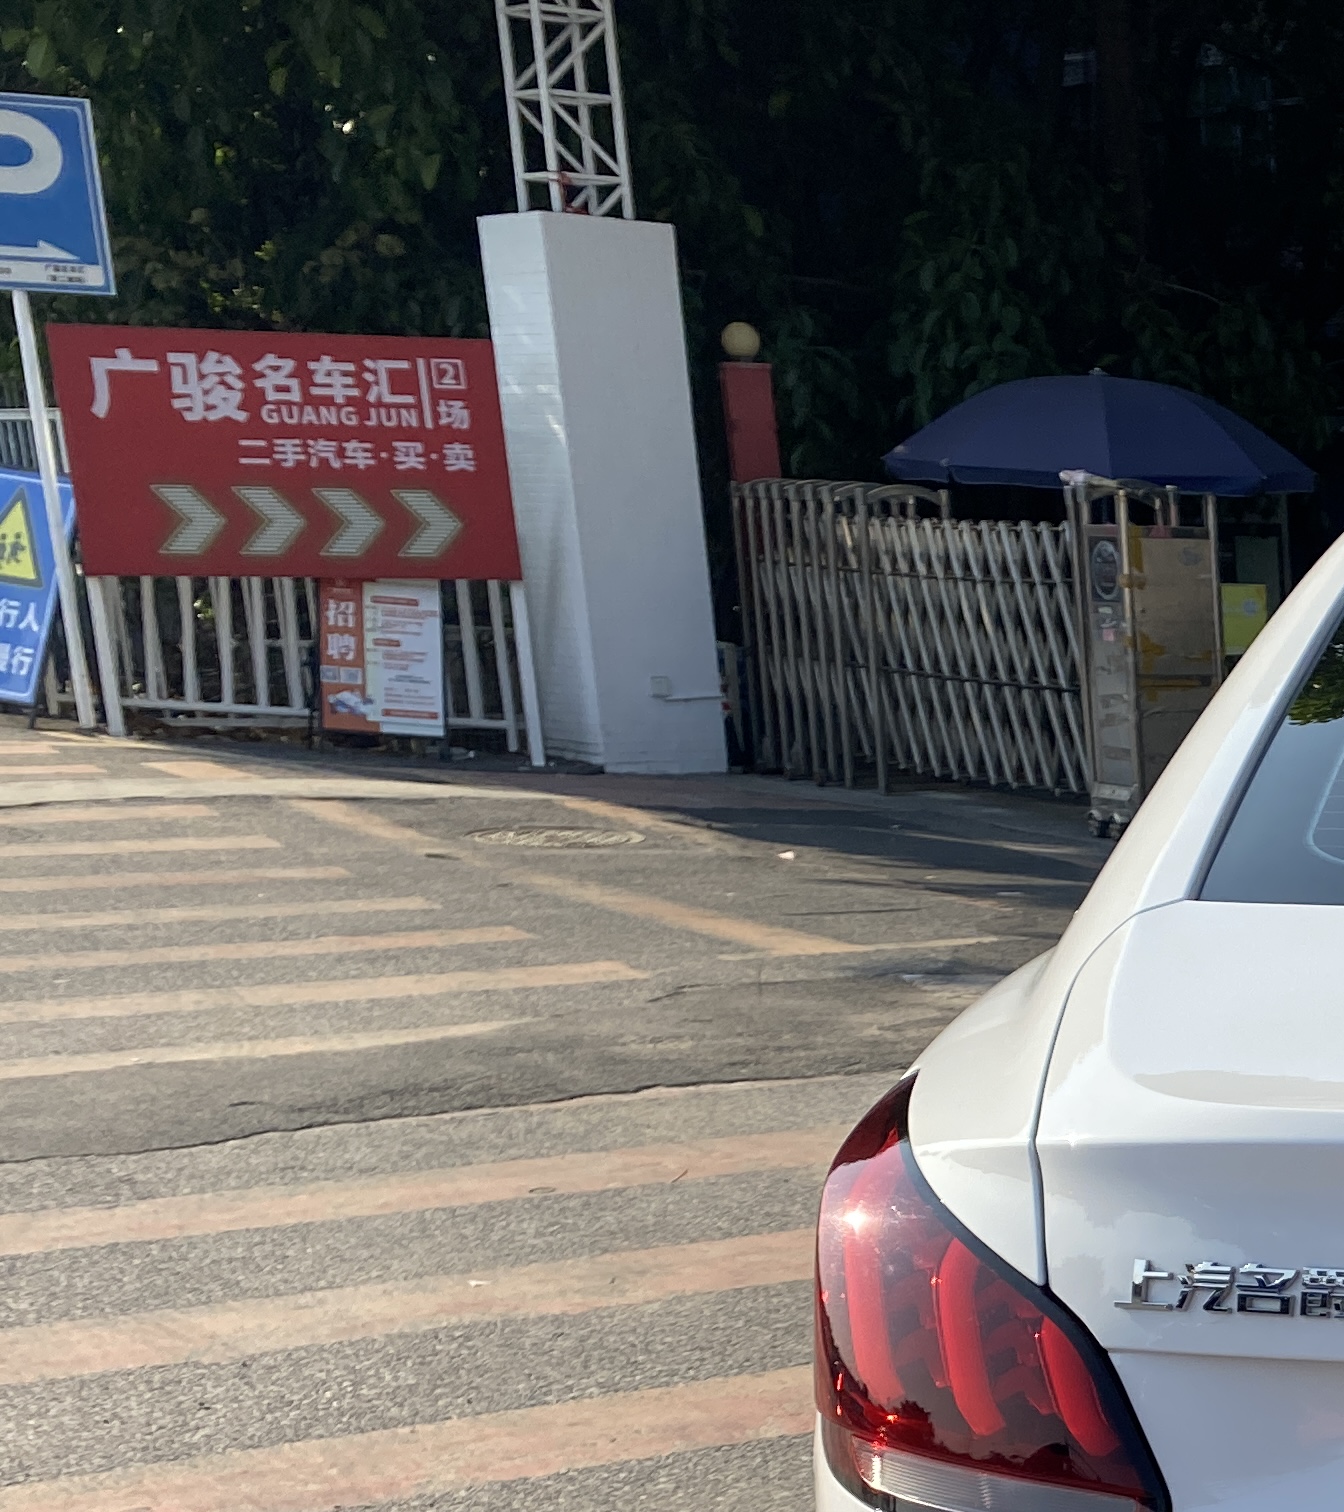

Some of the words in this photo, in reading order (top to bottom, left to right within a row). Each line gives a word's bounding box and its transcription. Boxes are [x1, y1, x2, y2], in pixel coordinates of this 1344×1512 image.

[88, 347, 418, 424] 广骏名车汇
[260, 404, 359, 427] GUANG
[364, 407, 419, 428] JUN
[437, 399, 472, 430] 场
